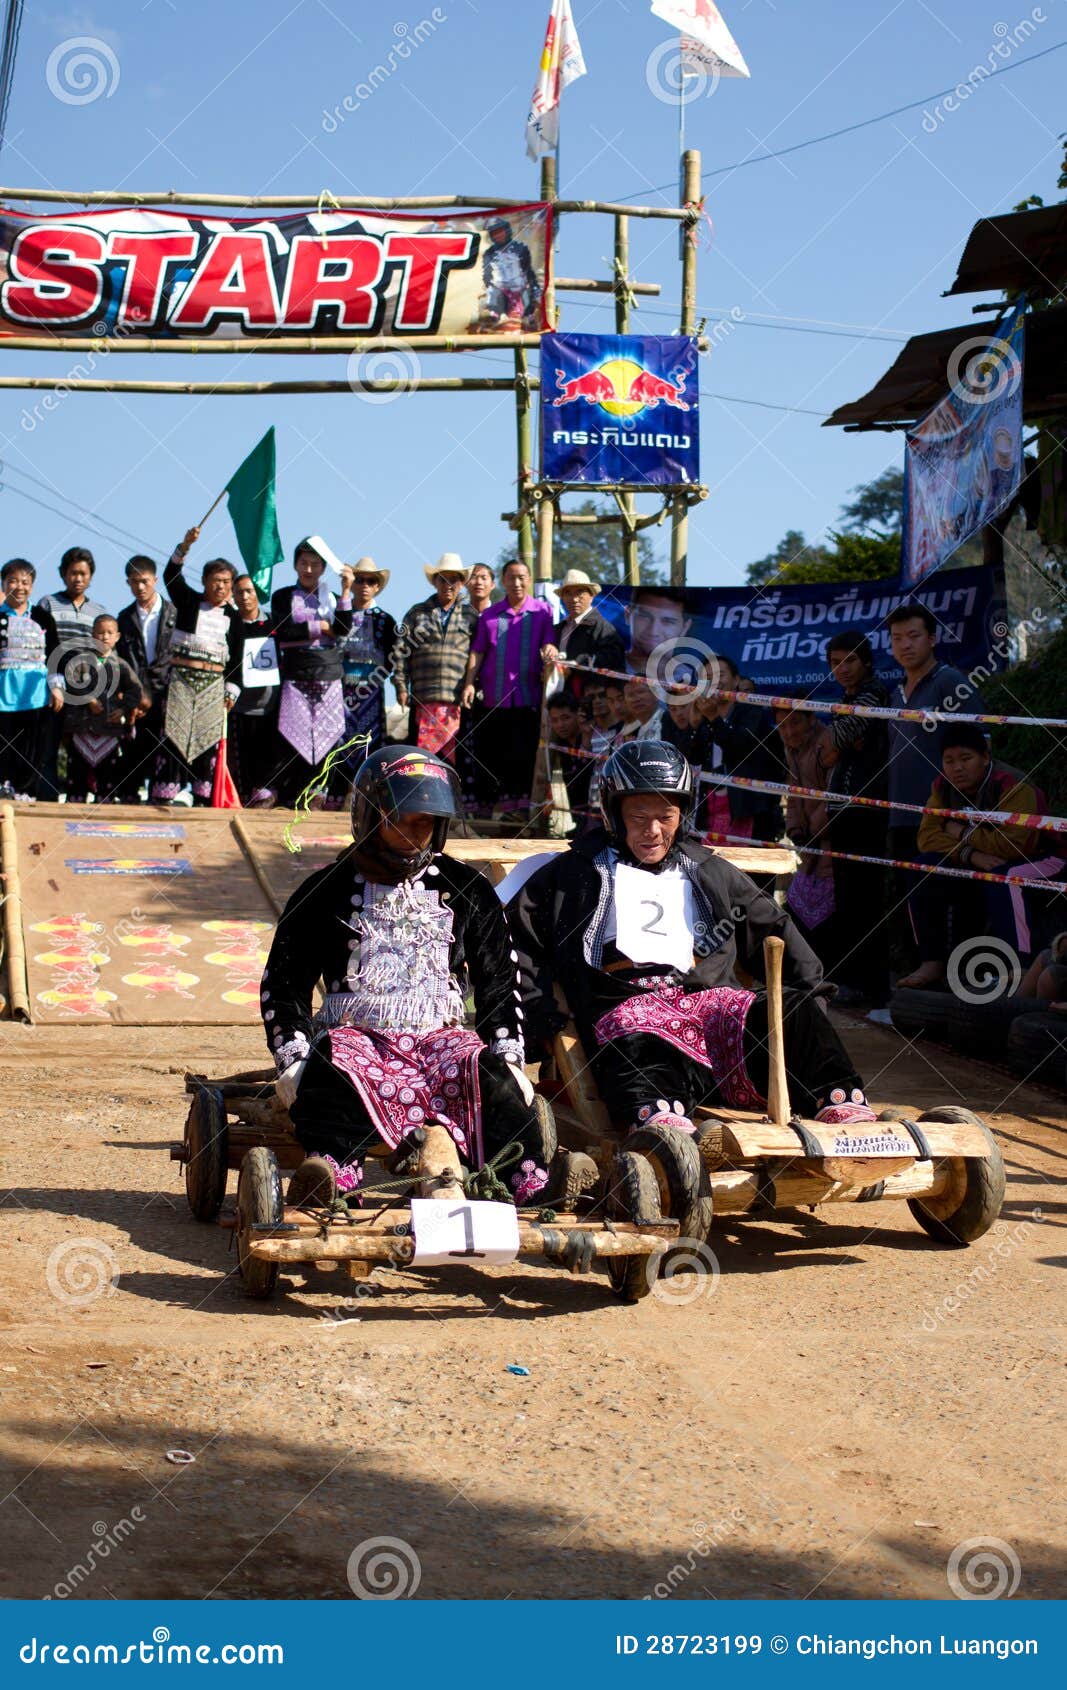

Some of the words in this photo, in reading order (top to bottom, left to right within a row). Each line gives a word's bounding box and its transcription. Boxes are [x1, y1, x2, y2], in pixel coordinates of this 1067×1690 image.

[2, 224, 476, 332] START
[552, 427, 691, 449] กระทิงแดง
[246, 649, 273, 669] 15
[640, 760, 672, 769] HONDA
[641, 900, 667, 936] 2
[448, 1206, 486, 1258] 1
